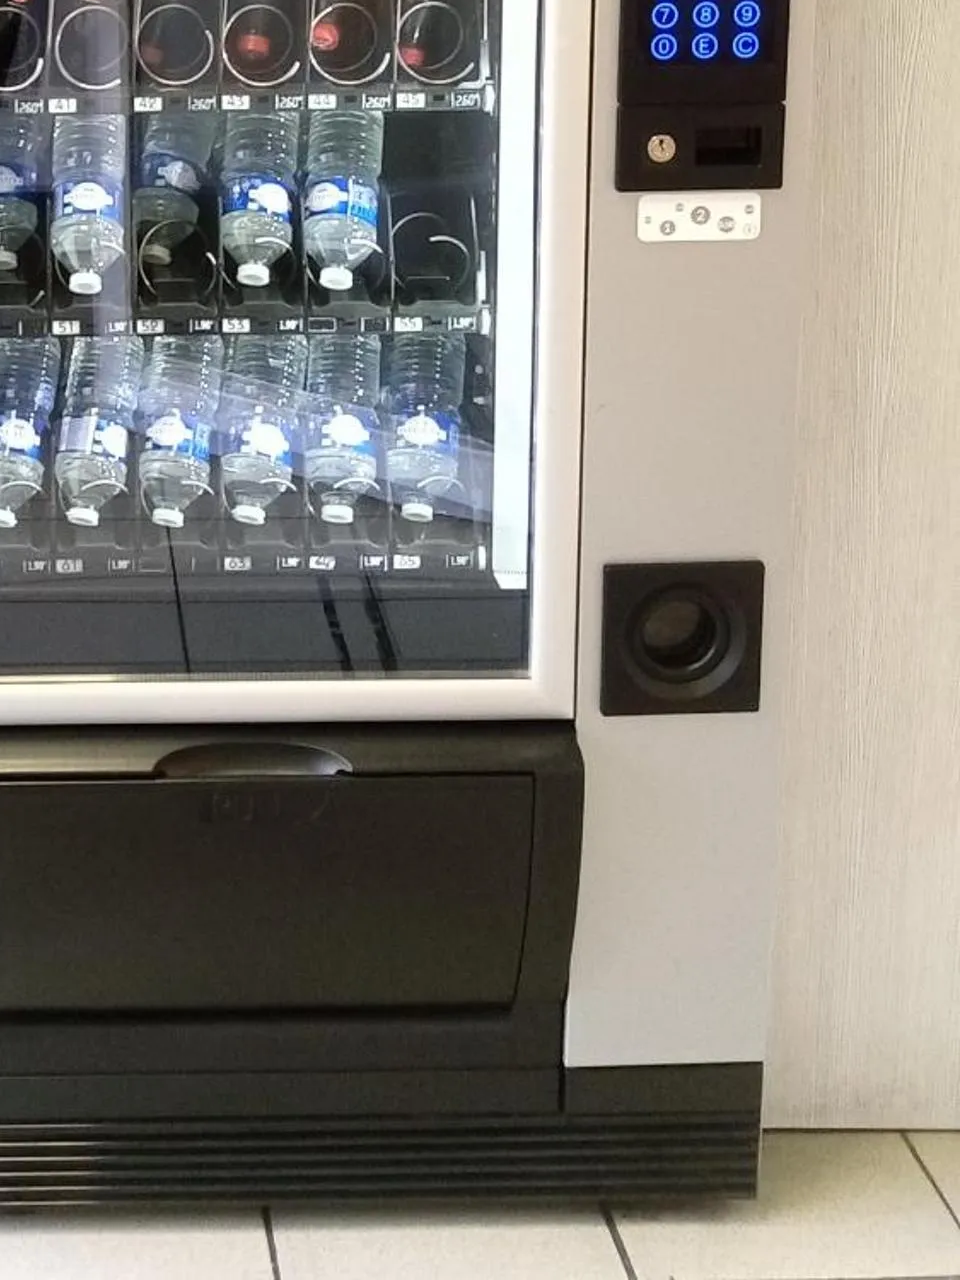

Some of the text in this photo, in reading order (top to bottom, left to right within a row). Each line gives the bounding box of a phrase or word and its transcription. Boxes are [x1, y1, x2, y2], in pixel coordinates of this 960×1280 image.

[659, 6, 752, 22] 7 8 9
[659, 37, 753, 54] 0 E C
